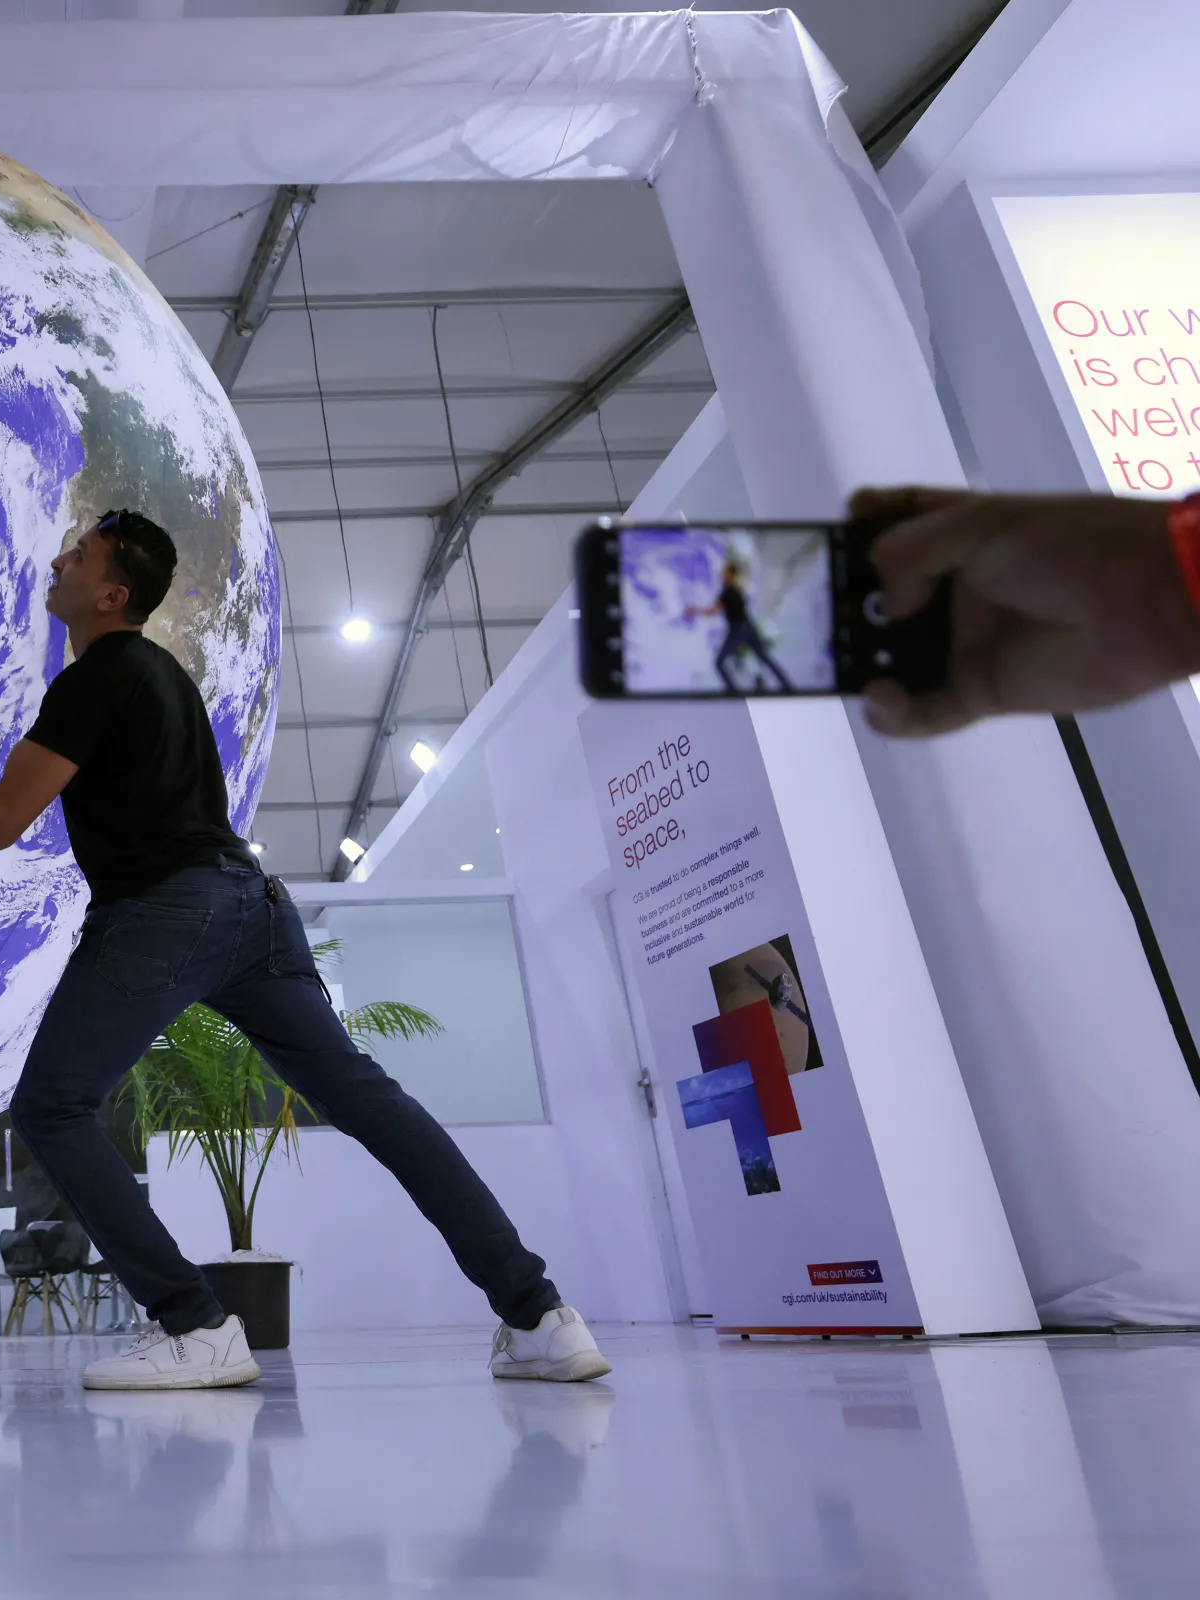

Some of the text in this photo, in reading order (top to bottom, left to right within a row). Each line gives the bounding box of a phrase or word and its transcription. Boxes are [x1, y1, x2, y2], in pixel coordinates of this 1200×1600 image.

[1053, 300, 1150, 338] Our
[1069, 347, 1200, 387] is ch
[1112, 452, 1173, 490] to
[607, 734, 691, 807] From the
[616, 760, 710, 837] seabed to
[623, 818, 686, 870] space,
[632, 894, 644, 905] CGI
[650, 875, 673, 895] trusted
[673, 872, 680, 882] to
[680, 867, 690, 878] do
[690, 851, 720, 872] complex
[719, 837, 743, 856] things
[743, 826, 761, 843] well.
[637, 859, 750, 924] We are proud of being a responsible
[640, 869, 765, 939] business and are committed to a more
[643, 890, 755, 952] inclusive and sustainable world for
[646, 950, 665, 965] future
[782, 1289, 888, 1306] cgi.com/uk/sustainability
[813, 1268, 866, 1280] FIND OUT MORE
